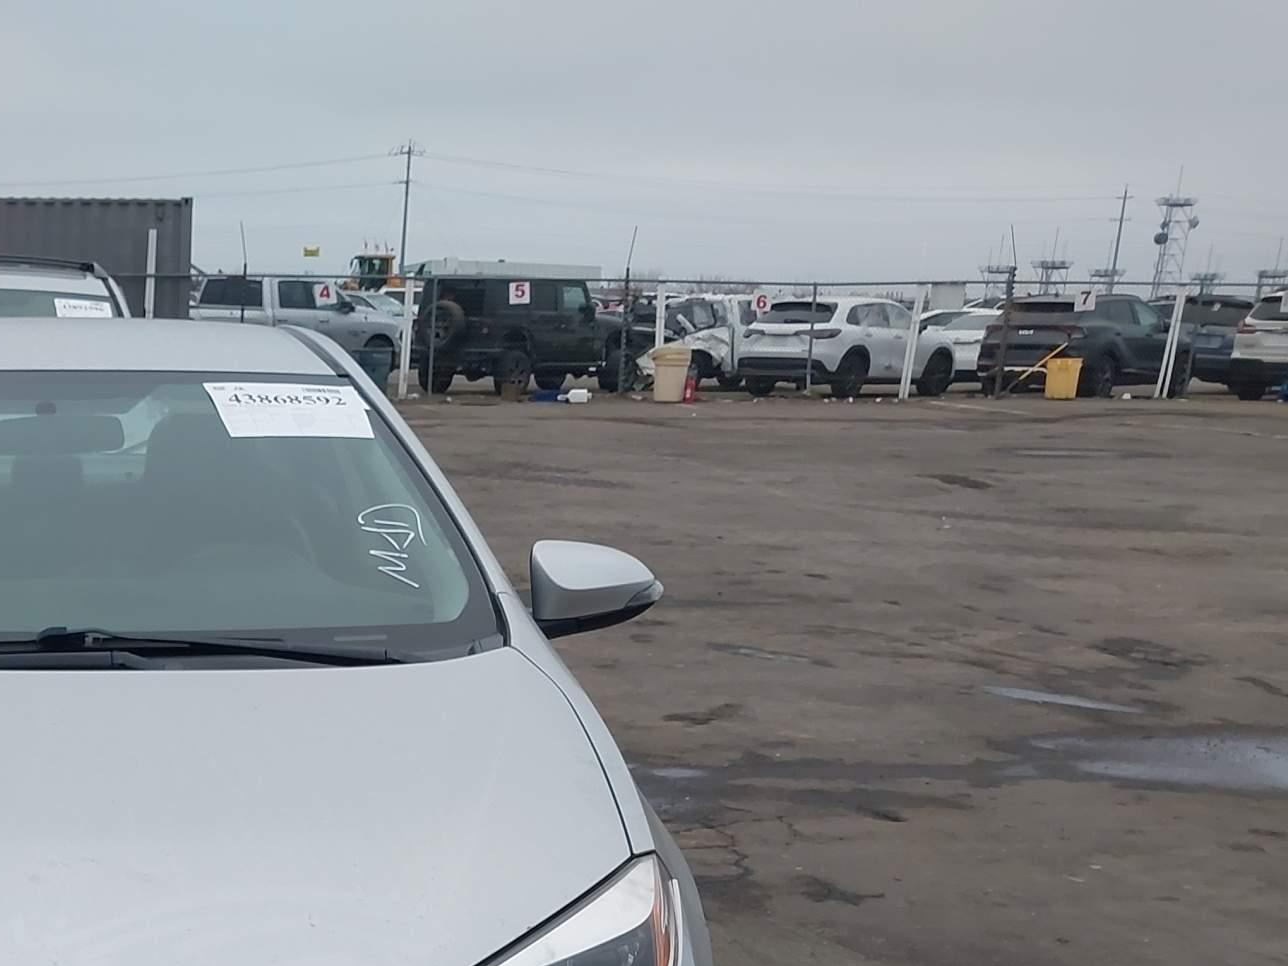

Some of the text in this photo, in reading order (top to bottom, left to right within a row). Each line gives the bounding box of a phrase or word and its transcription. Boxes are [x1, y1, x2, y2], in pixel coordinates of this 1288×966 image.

[319, 285, 330, 300] 4
[514, 284, 526, 299] 5
[1080, 290, 1092, 305] 7
[756, 294, 768, 309] 6
[228, 393, 347, 406] 43868592
